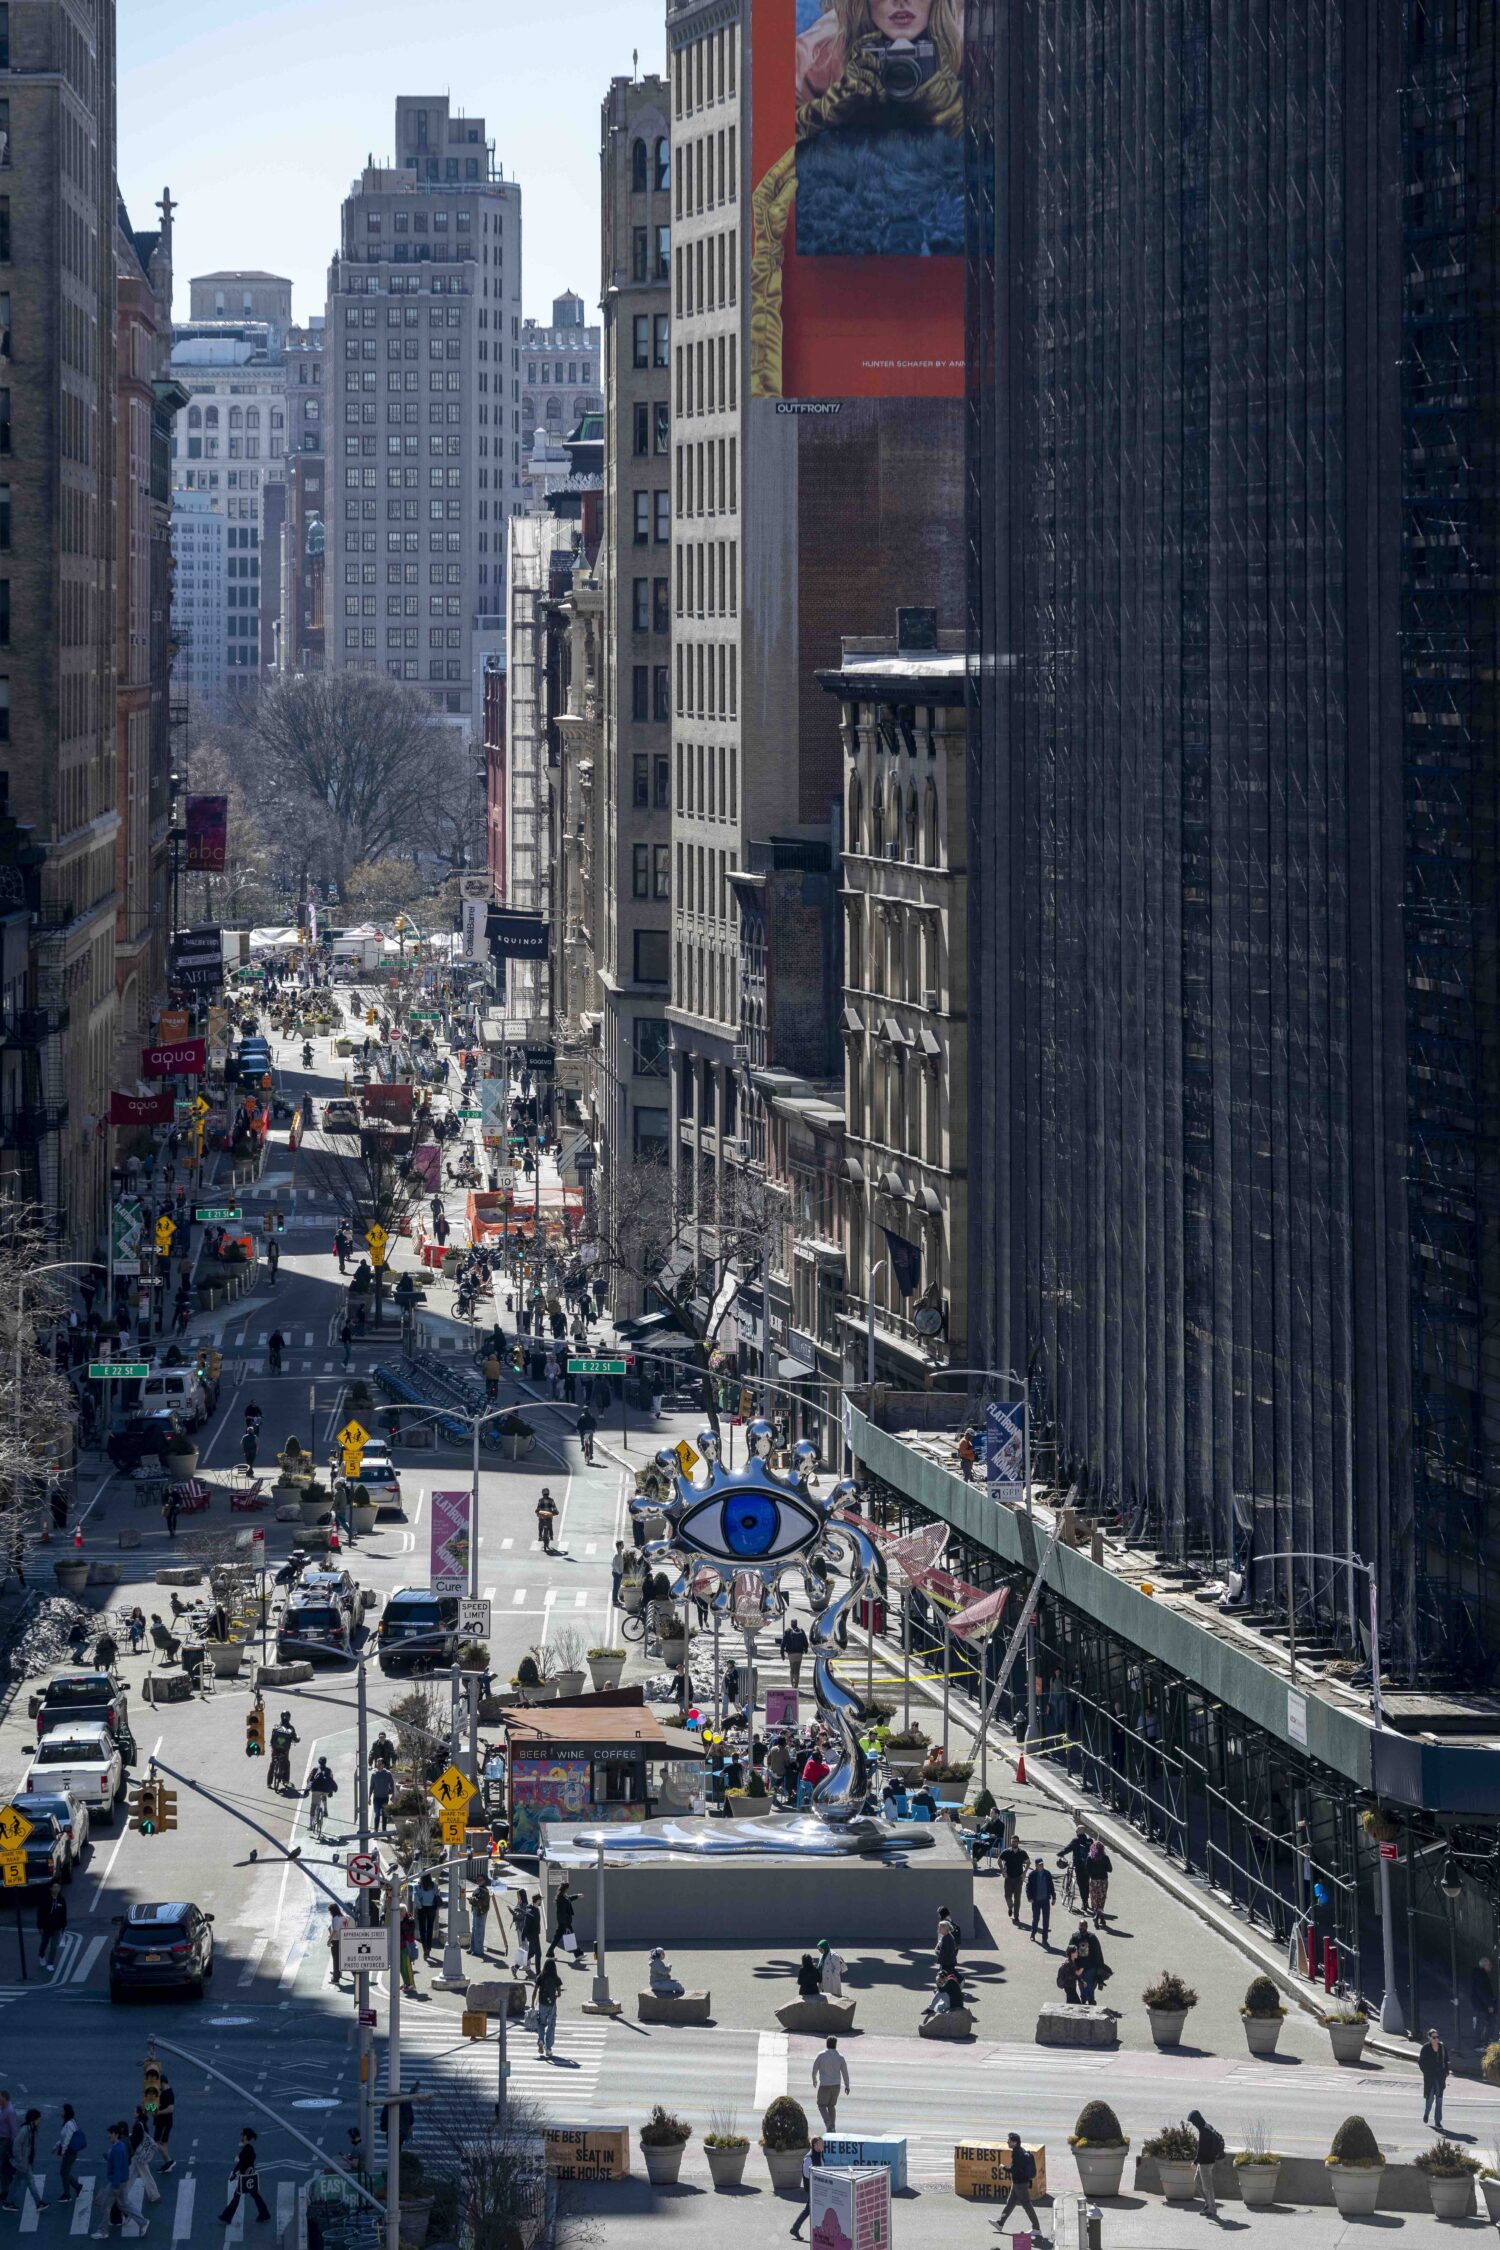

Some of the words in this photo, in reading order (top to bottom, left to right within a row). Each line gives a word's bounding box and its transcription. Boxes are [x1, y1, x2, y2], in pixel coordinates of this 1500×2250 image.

[862, 360, 895, 368] HUNTER
[896, 360, 934, 368] SCHAFER
[935, 360, 947, 368] BY
[189, 831, 225, 860] abc
[465, 906, 476, 957] Crate&Barrel
[498, 935, 543, 945] EQUINOX
[151, 1050, 196, 1071] aqua
[128, 1101, 158, 1116] aqua
[467, 1110, 471, 1118] E
[471, 1110, 479, 1118] 20
[501, 1177, 511, 1187] 10
[208, 1210, 212, 1218] E
[214, 1210, 221, 1218] 21
[104, 1367, 109, 1376] E
[112, 1367, 122, 1376] 22
[125, 1367, 133, 1376] St
[583, 1362, 587, 1371] E
[590, 1362, 599, 1371] 22
[602, 1362, 611, 1371] St
[986, 1403, 1021, 1436] FLATIRON
[349, 1463, 356, 1471] 5
[992, 1453, 1018, 1481] NOMAD
[432, 1492, 469, 1529] FLATIRON
[435, 1545, 464, 1575] NOMAD
[461, 1603, 488, 1611] SPEED
[464, 1611, 485, 1619] LIMIT
[519, 1750, 548, 1759] BEER
[556, 1750, 585, 1759] WINE
[594, 1750, 637, 1759] COFFEE
[449, 1824, 458, 1836] 5
[9, 1865, 19, 1876] 5
[541, 2129, 560, 2142] THE
[562, 2130, 587, 2149] BEST
[823, 2141, 837, 2154] HE
[838, 2142, 864, 2158] BEST
[955, 2147, 974, 2161] THE
[976, 2148, 1002, 2163] BEST
[575, 2149, 601, 2166] SEAT
[603, 2150, 614, 2163] IN
[556, 2165, 576, 2180] THE
[577, 2166, 613, 2180] HOUSE
[991, 2167, 1011, 2181] SEA
[320, 2179, 347, 2194] EASY
[971, 2183, 992, 2198] THE
